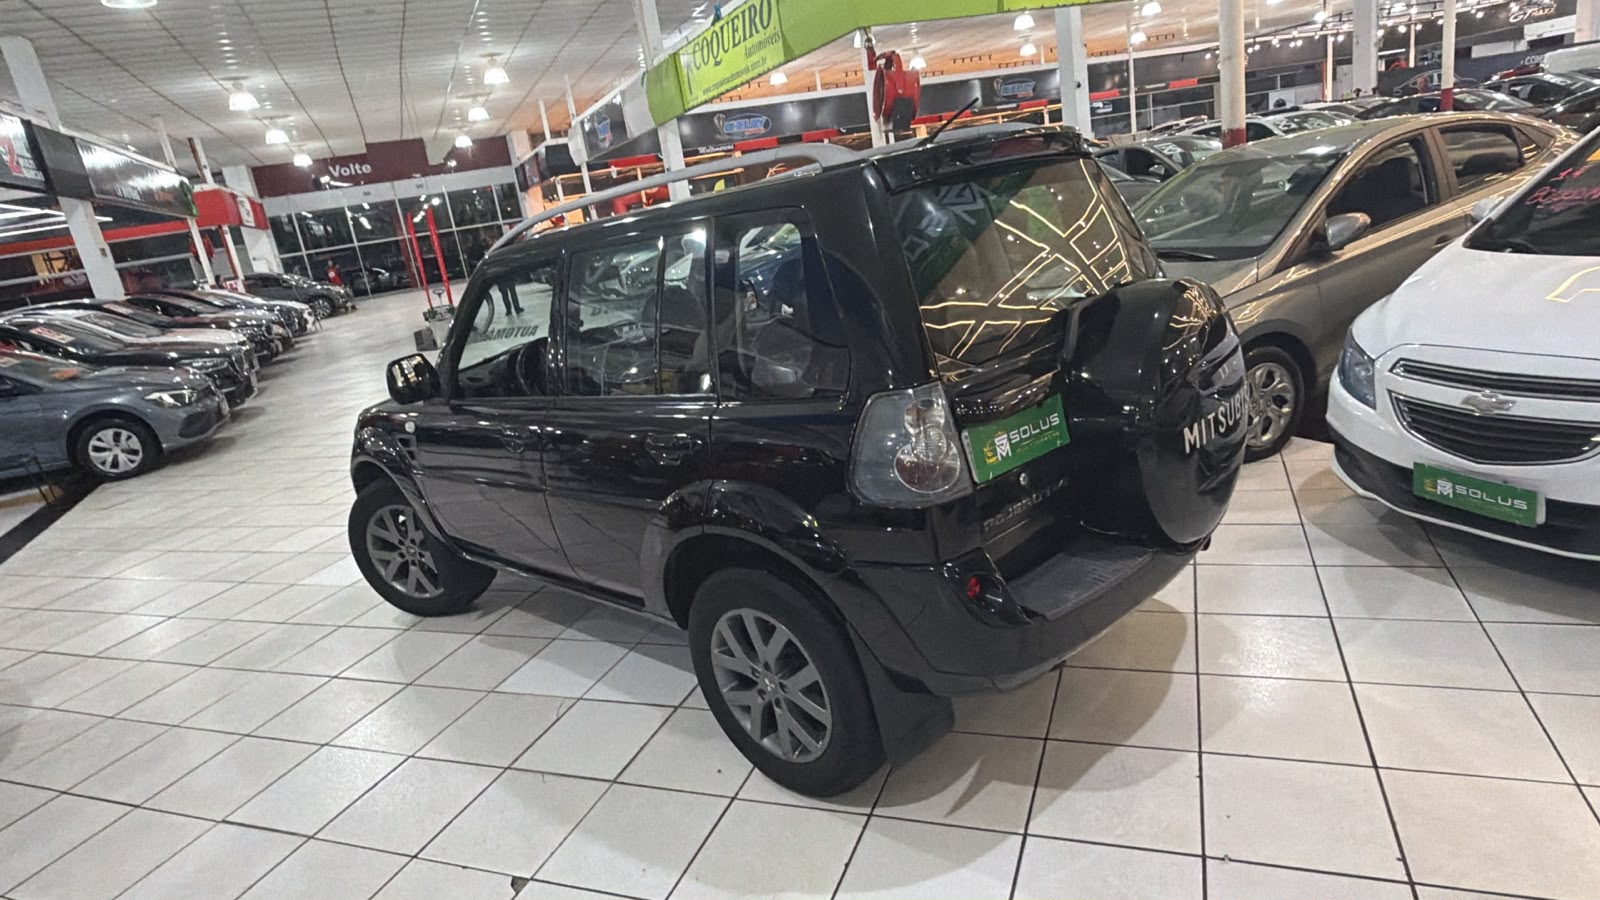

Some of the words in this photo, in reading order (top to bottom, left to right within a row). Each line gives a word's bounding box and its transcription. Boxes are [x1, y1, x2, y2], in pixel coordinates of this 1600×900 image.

[693, 0, 771, 70] COQUEIRO
[328, 163, 371, 177] Volte
[1009, 413, 1060, 443] SOLUS
[1455, 485, 1527, 510] SOLUS
